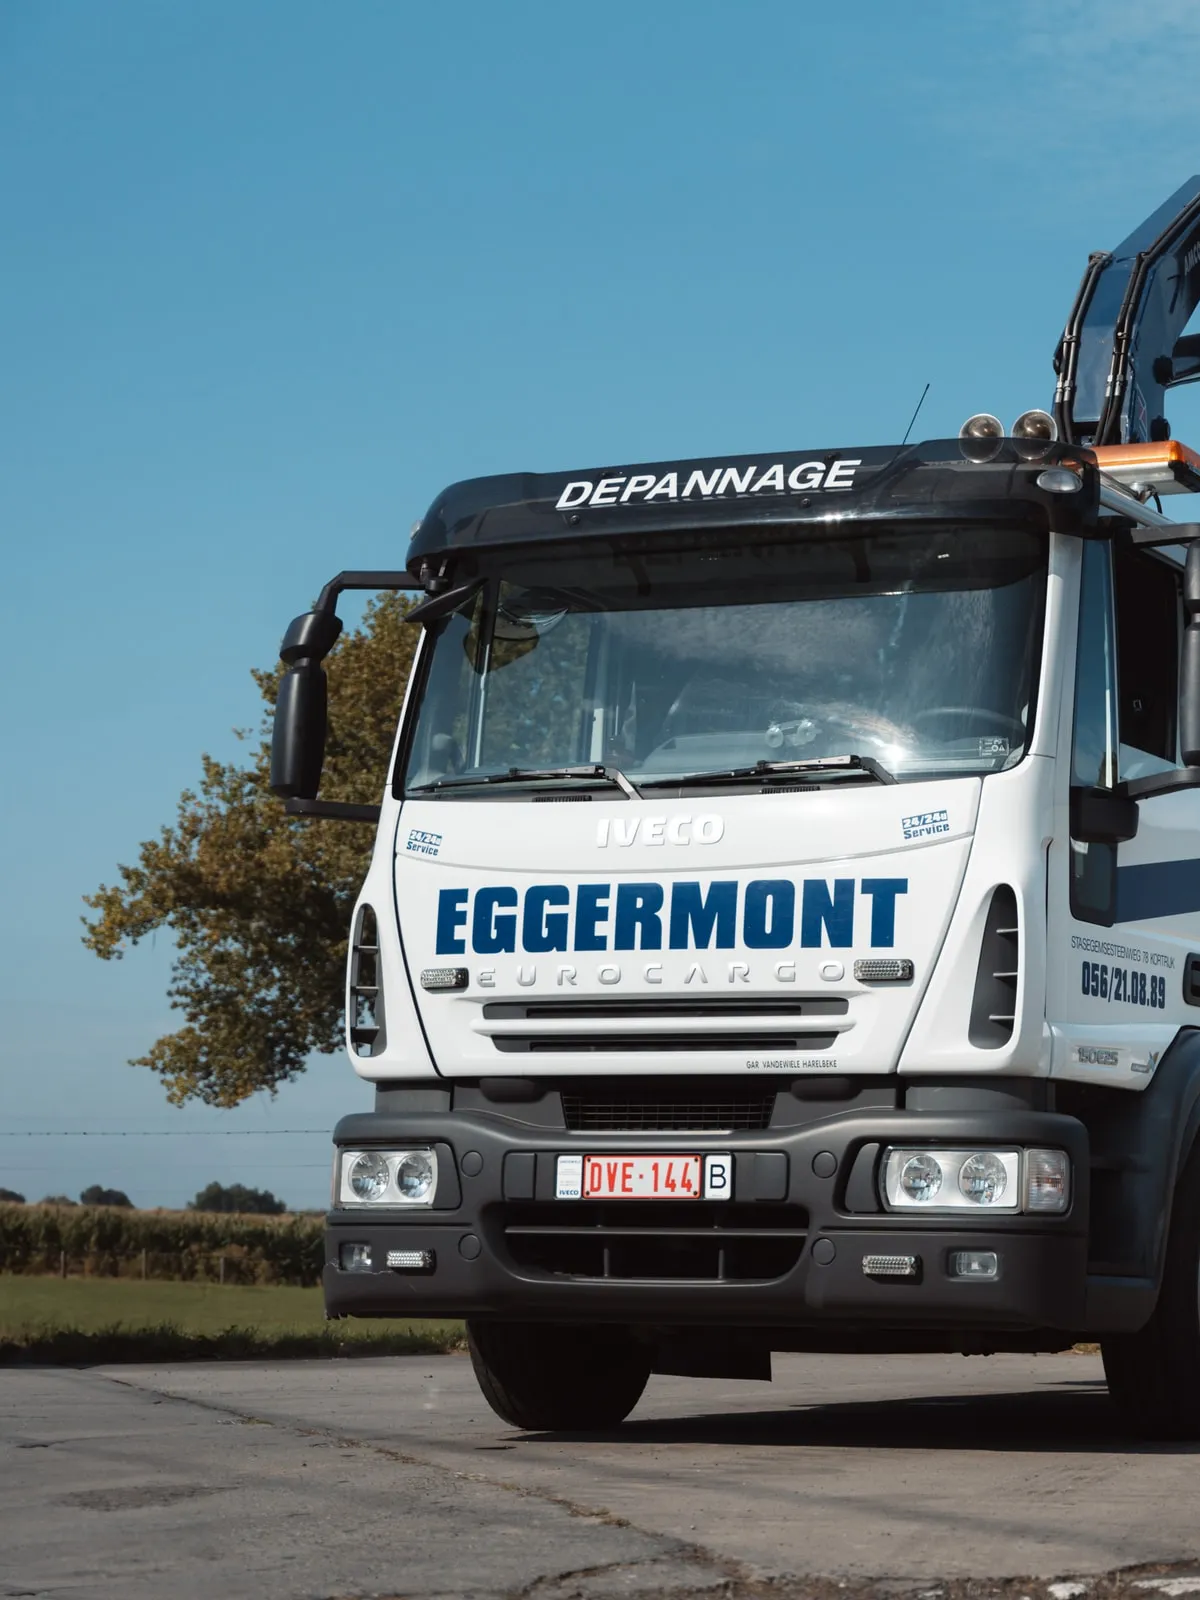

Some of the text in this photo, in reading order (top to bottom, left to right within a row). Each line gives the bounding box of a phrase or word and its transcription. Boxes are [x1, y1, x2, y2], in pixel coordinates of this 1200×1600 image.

[556, 460, 861, 508] DEPANNAGE
[597, 813, 725, 848] IVECO
[904, 823, 949, 840] Service
[406, 841, 439, 856] Service
[435, 878, 908, 955] EGGERMONT
[477, 961, 846, 987] EUROCARGO
[1082, 961, 1165, 1009] 056/21.08.89
[762, 1060, 800, 1069] VANDEWIELE
[802, 1059, 837, 1068] HARELBEKE
[710, 1164, 726, 1189] B
